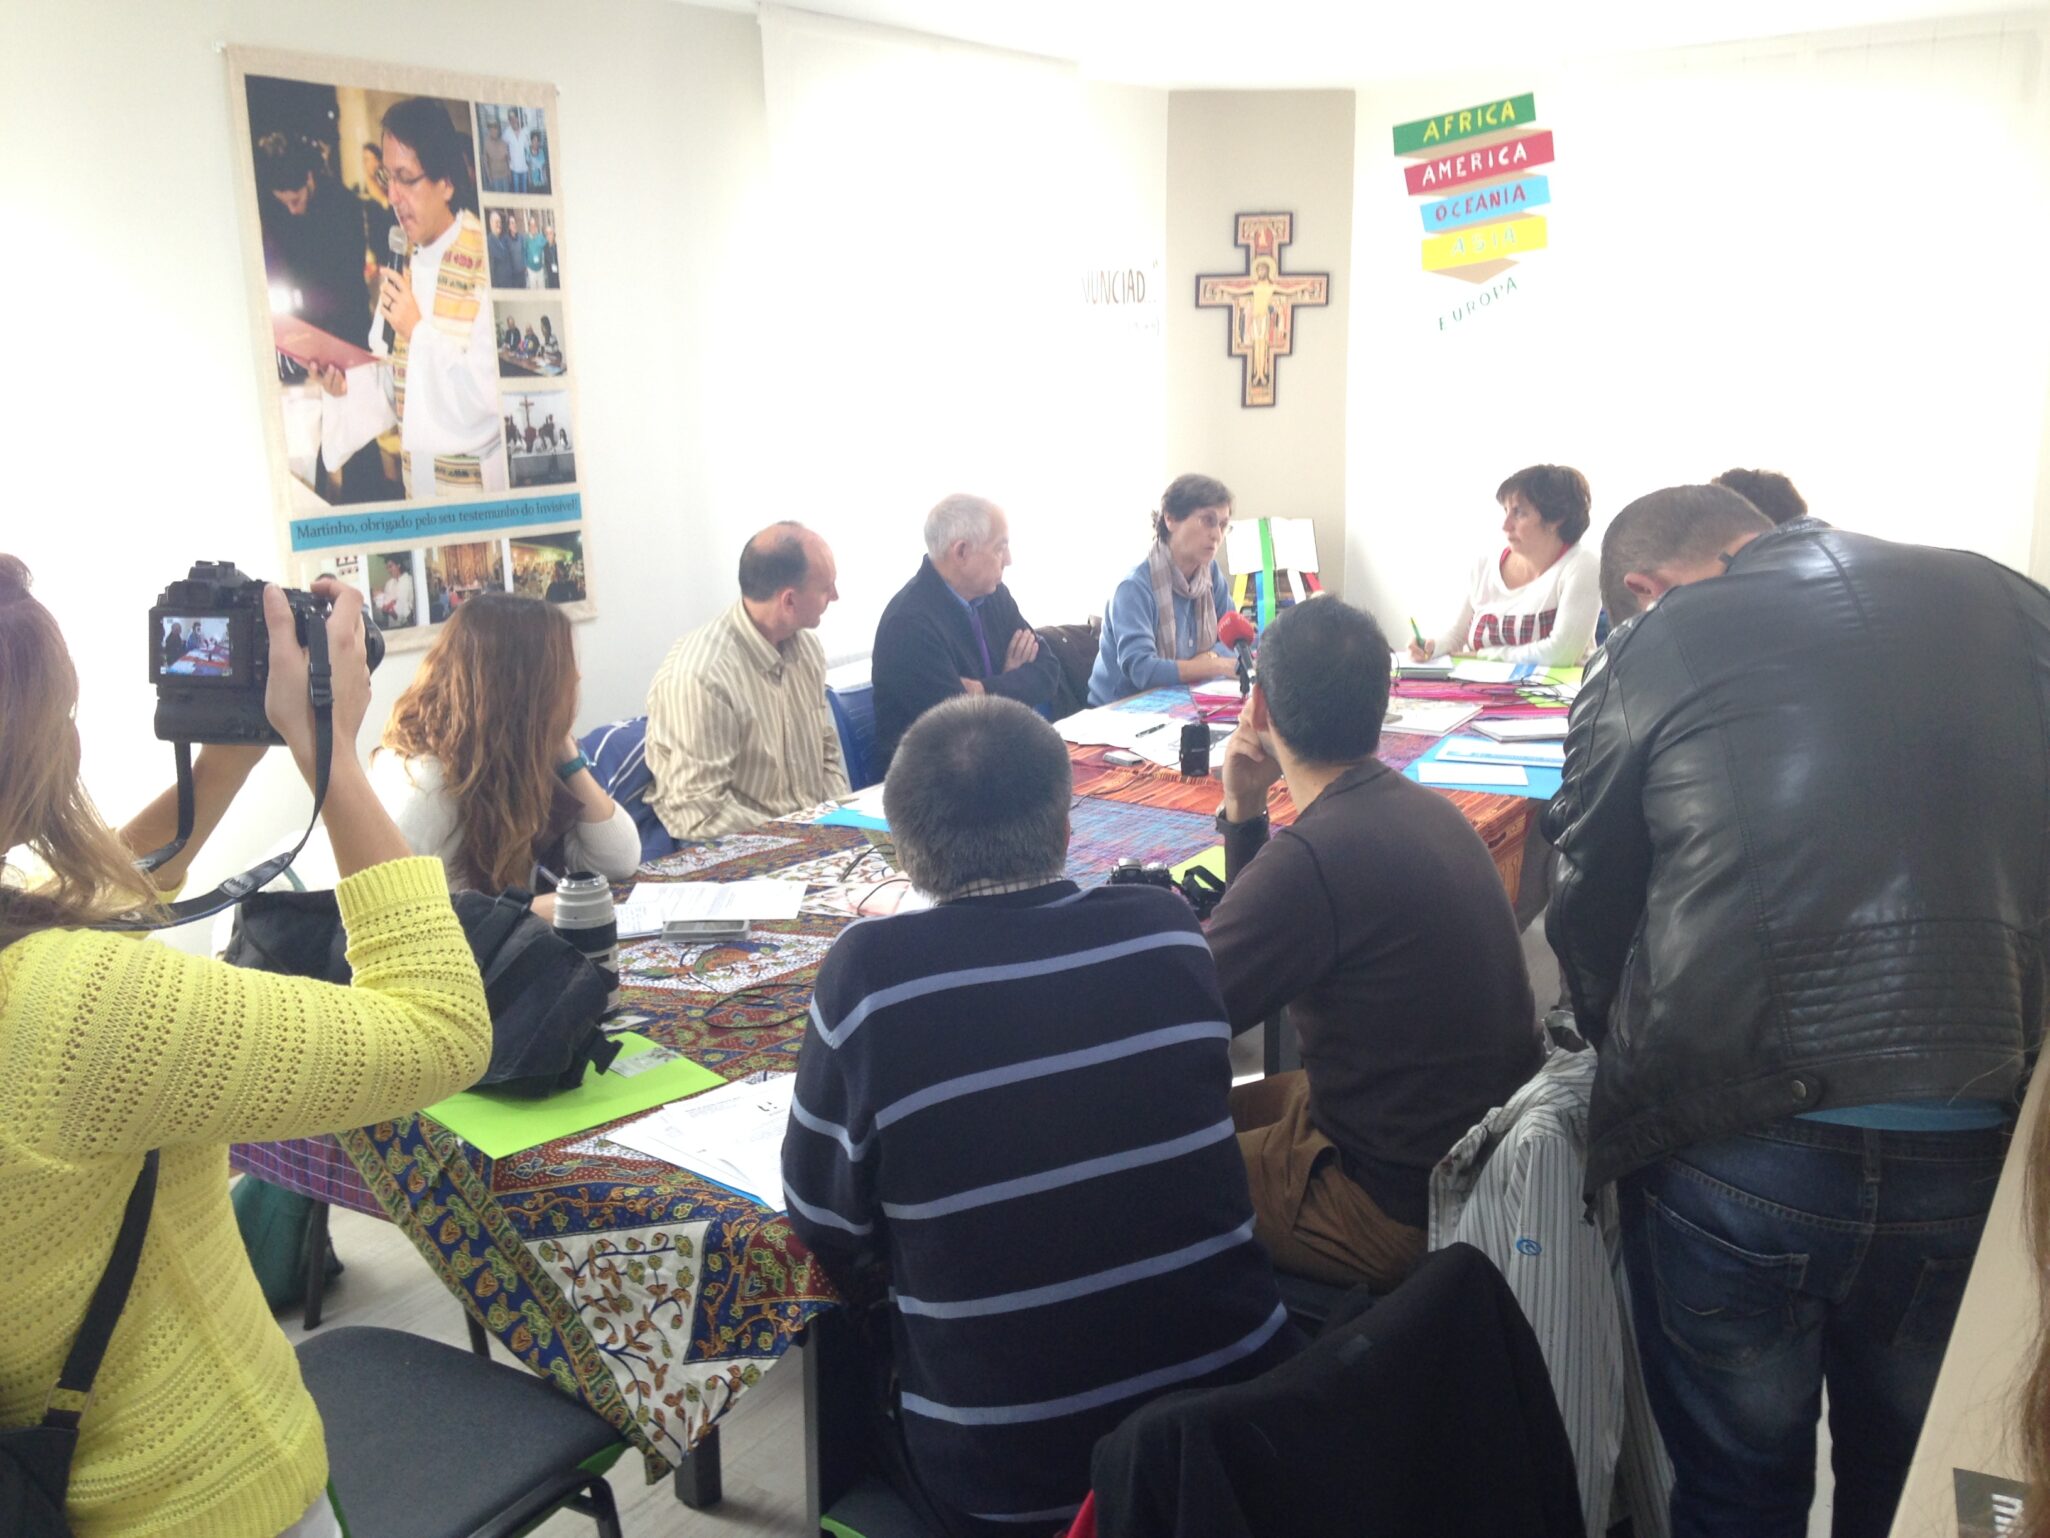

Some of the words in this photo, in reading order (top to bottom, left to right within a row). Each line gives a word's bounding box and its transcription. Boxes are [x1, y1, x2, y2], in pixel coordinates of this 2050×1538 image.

[1423, 100, 1516, 143] AFRICA
[1422, 142, 1528, 186] AMERICA
[1435, 183, 1527, 222] OCEANIA
[1452, 225, 1517, 256] ASIA
[1438, 276, 1518, 331] EUROPA
[296, 520, 358, 540] Martinho,
[360, 514, 413, 534] obrigado
[415, 512, 437, 530] pelo
[439, 513, 456, 524] seu
[459, 504, 520, 522] testemunho
[521, 502, 535, 517] do
